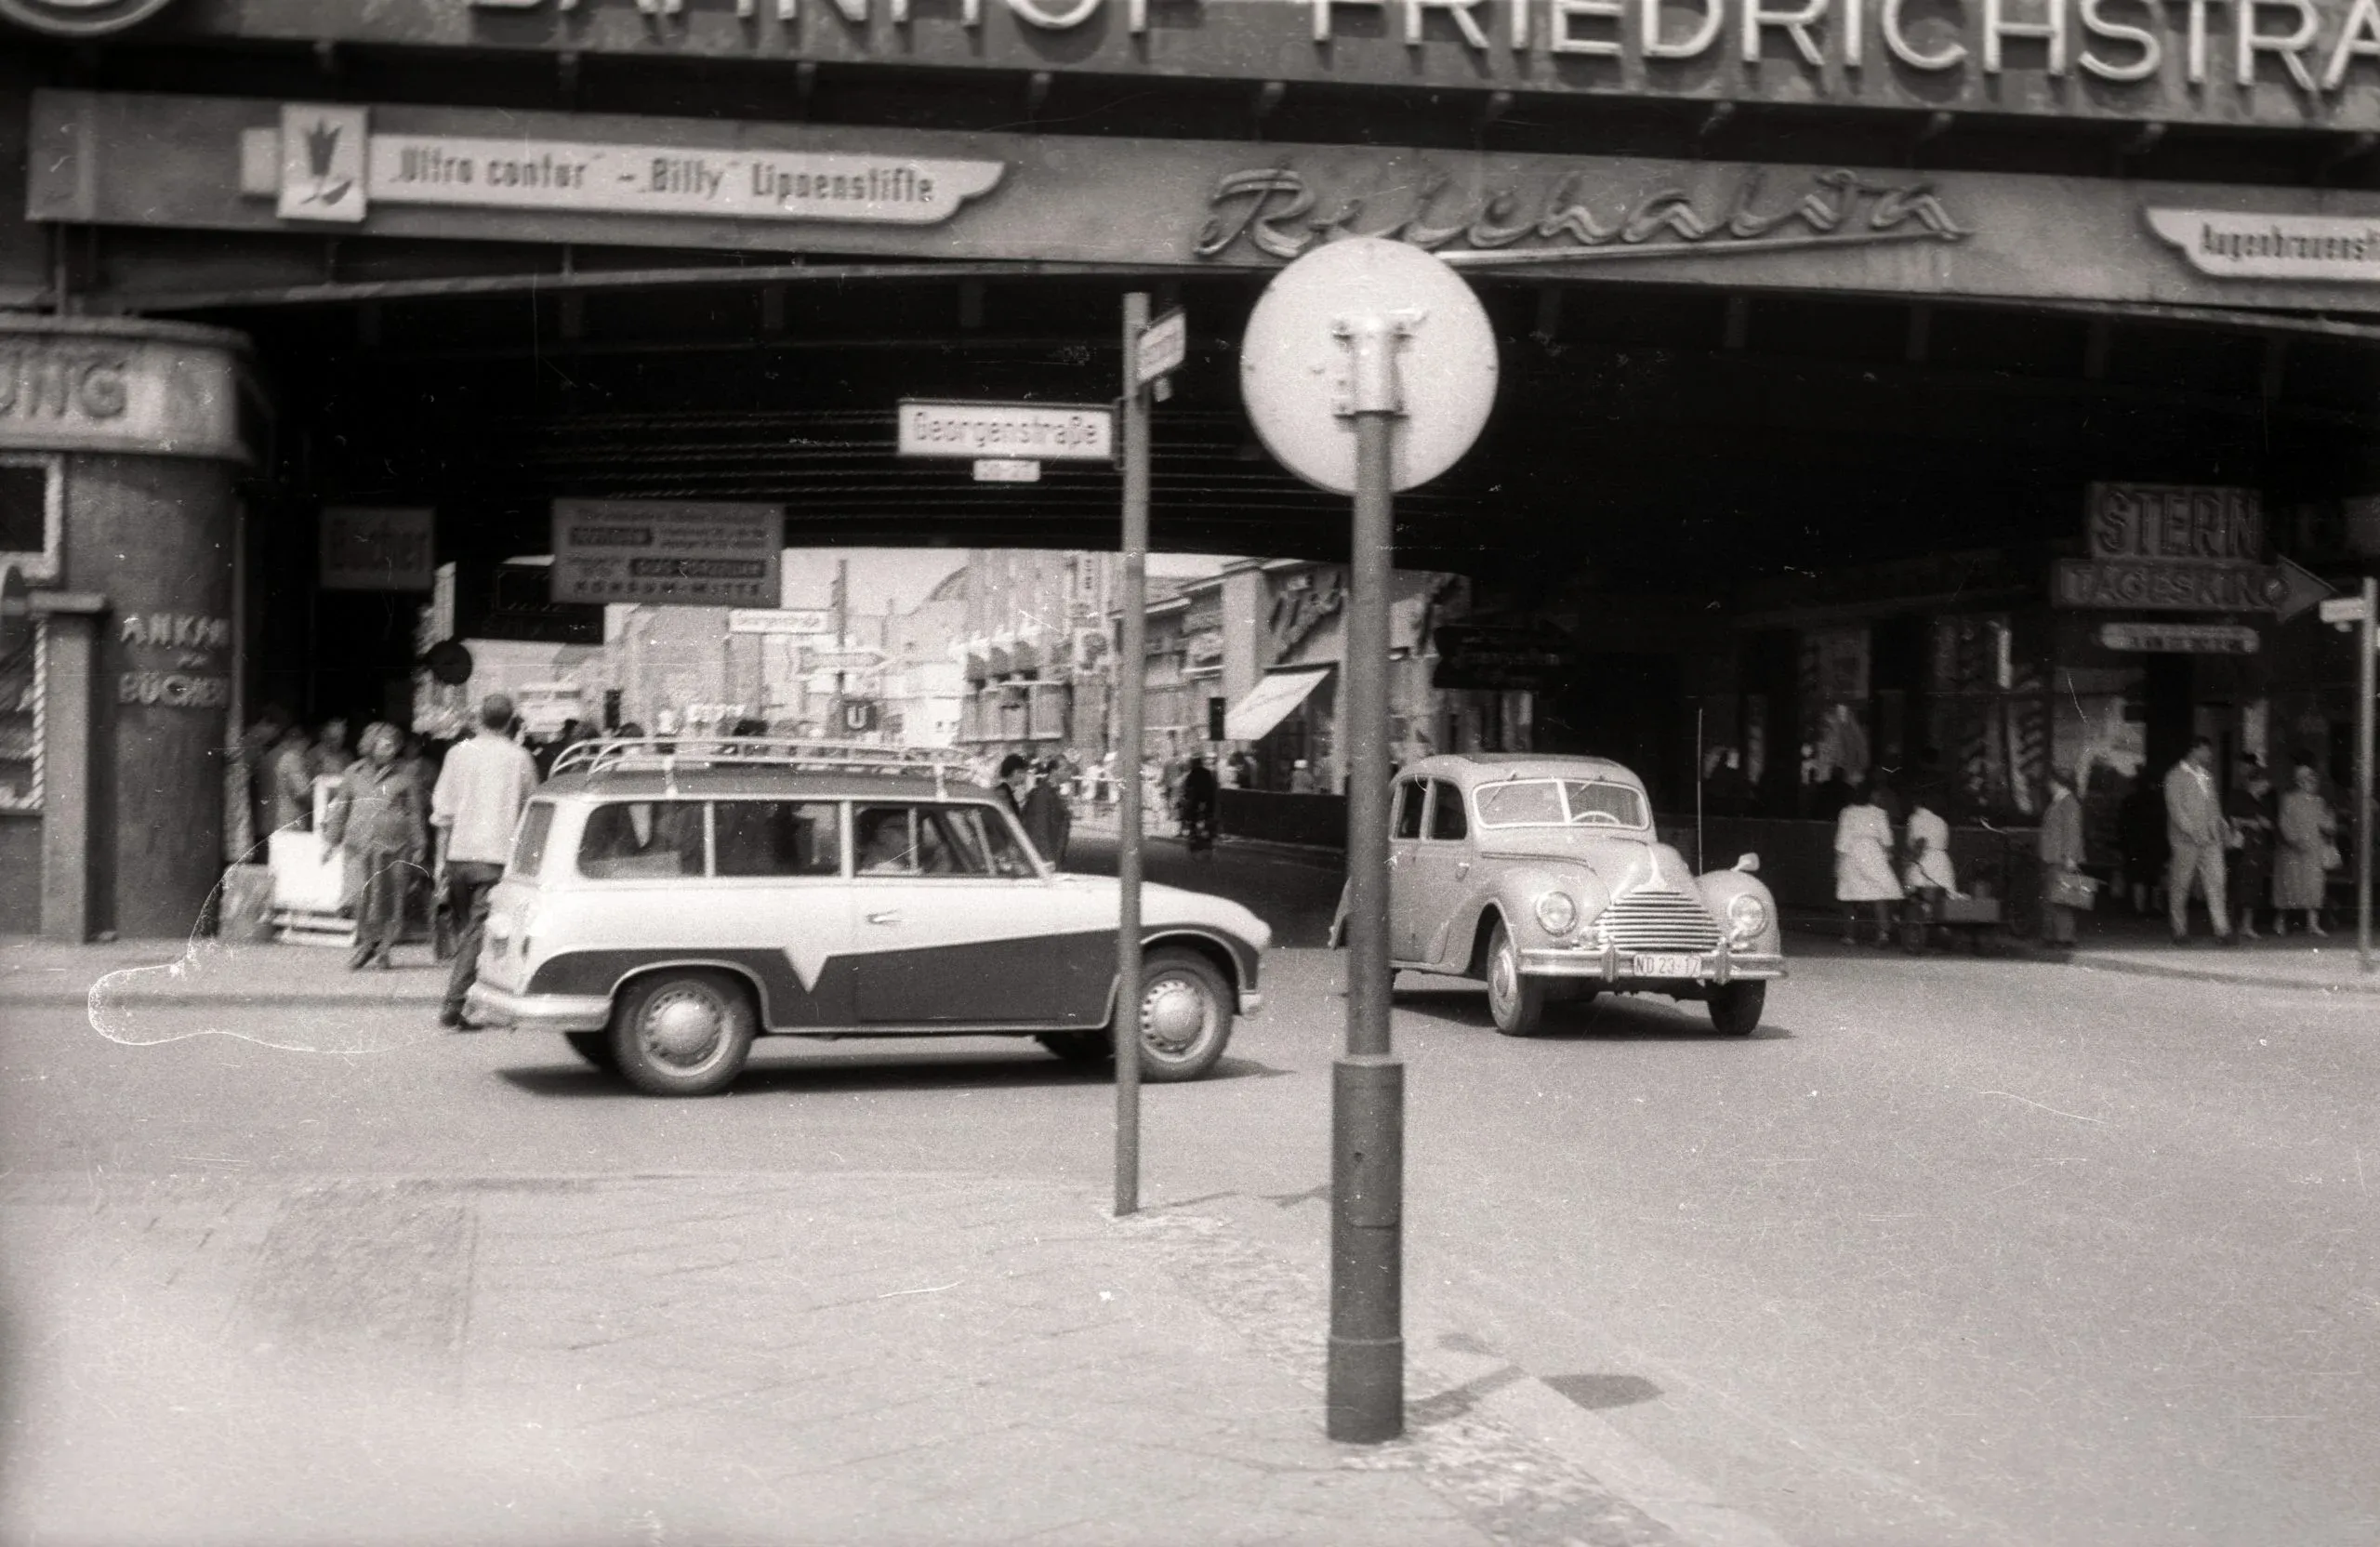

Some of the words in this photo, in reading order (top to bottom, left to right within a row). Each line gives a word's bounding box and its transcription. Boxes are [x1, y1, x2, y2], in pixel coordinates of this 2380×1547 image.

[914, 411, 1098, 449] Georgenstraße
[2098, 490, 2259, 557] STERN
[846, 707, 865, 730] U
